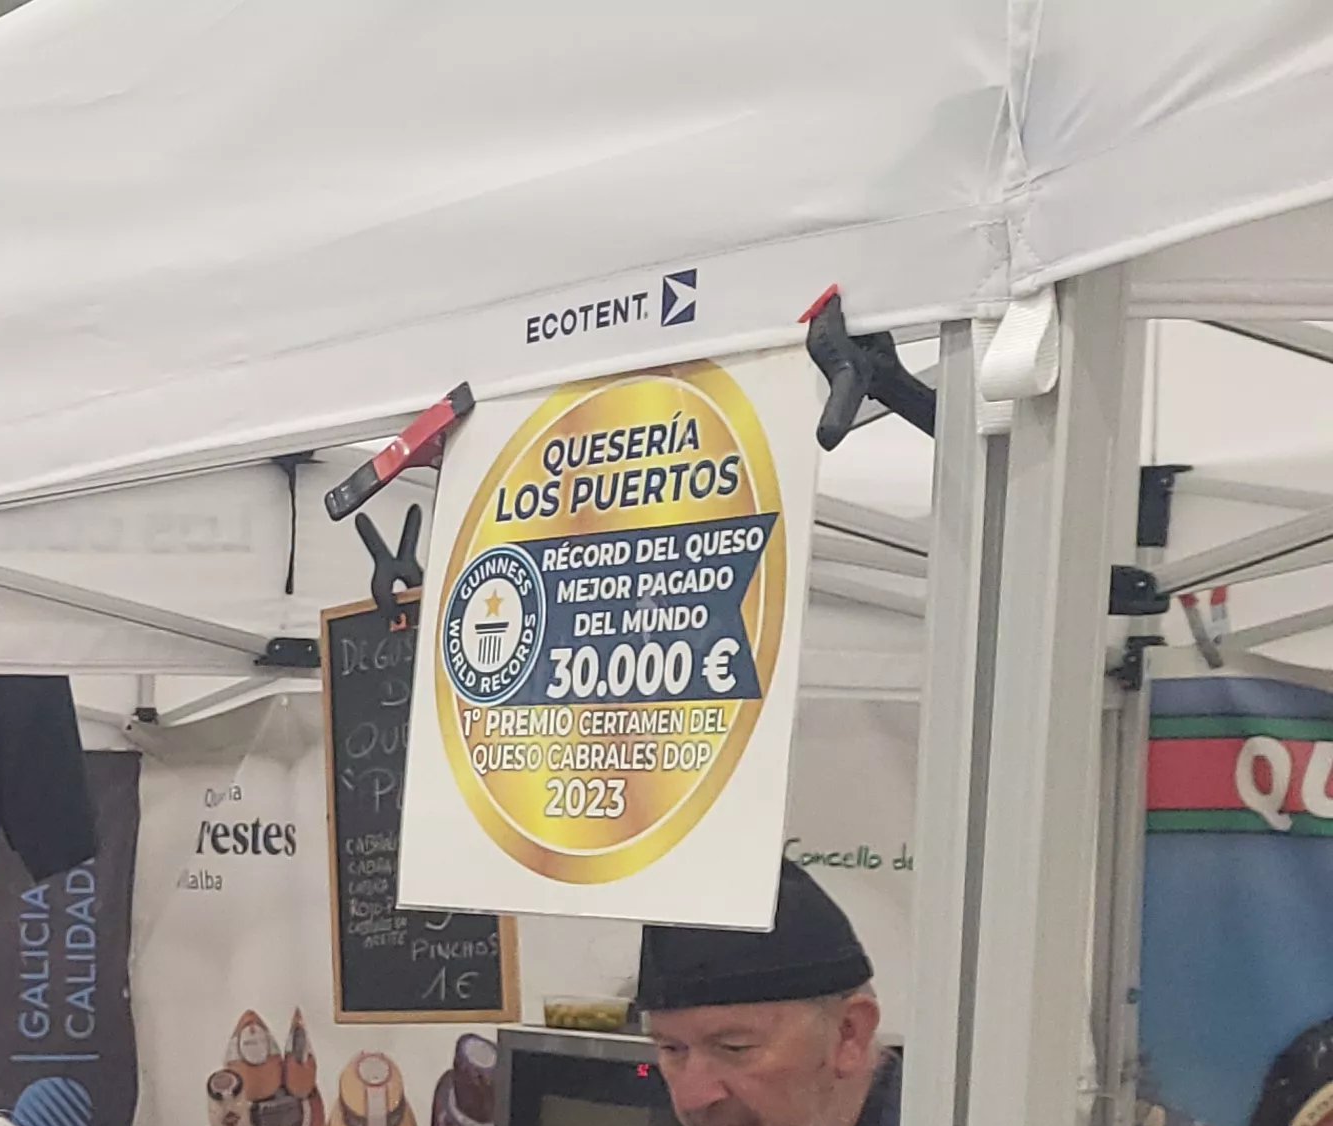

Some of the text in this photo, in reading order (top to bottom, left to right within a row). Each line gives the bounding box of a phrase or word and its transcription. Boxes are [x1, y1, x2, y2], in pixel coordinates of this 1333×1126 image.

[526, 292, 648, 344] ECOTENT
[543, 411, 700, 476] QUESERÍA
[495, 455, 741, 523] LOS PUERTOS
[542, 526, 765, 573] RÉCORD DEL QUESO
[460, 557, 533, 600] GUINNESS
[556, 566, 734, 604] MEJOR PAGADO
[574, 605, 709, 637] DEL MUNDO
[449, 612, 537, 694] WORLD RECORDS
[546, 638, 741, 699] 30.000 €
[485, 707, 573, 736] PREMIO
[578, 709, 684, 736] CERTAMEN
[689, 708, 728, 734] DEL
[472, 742, 711, 774] QUESO CABRALES DOP
[544, 778, 627, 818] 2023
[196, 816, 296, 857] restes
[782, 837, 883, 869] Concello
[18, 858, 97, 1040] GALICIA CALIDAD
[412, 931, 498, 962] PINCHOS
